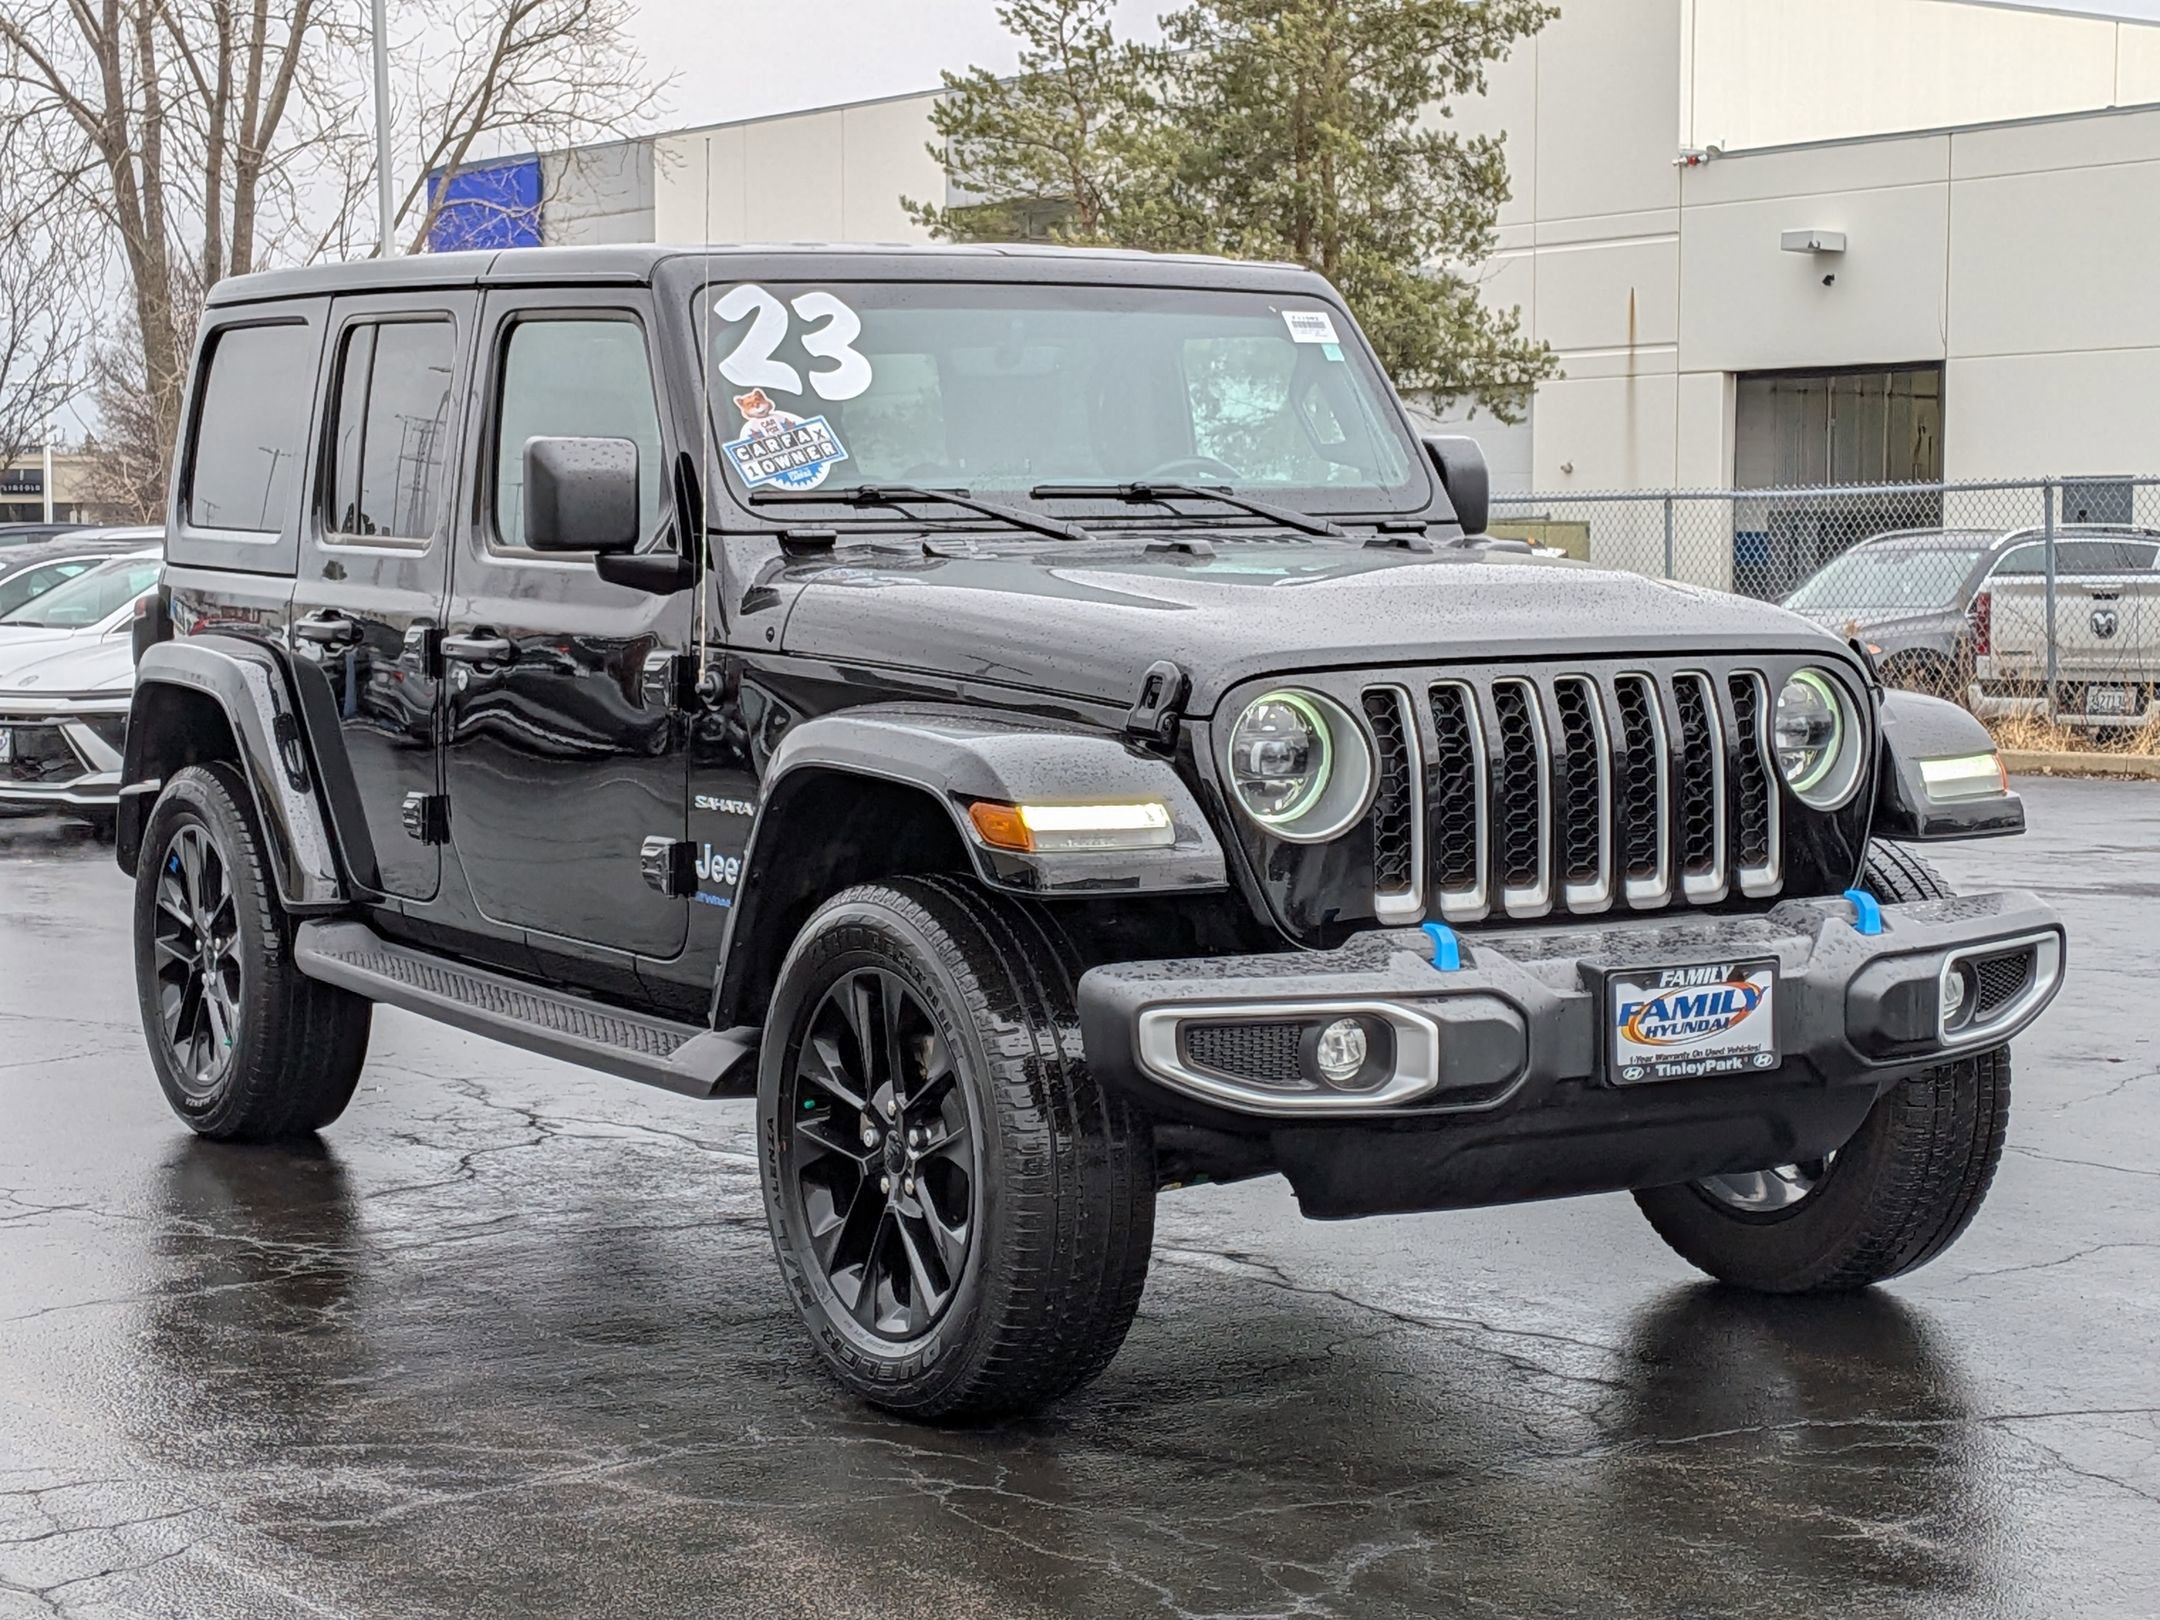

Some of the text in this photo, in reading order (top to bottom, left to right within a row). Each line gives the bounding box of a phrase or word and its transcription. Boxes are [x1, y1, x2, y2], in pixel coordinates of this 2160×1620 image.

[713, 284, 872, 400] 23
[736, 427, 827, 462] CARFAX
[746, 464, 760, 478] 1
[762, 442, 838, 474] OWNER
[694, 795, 754, 817] SAHARA
[695, 843, 740, 886] Jee
[1659, 965, 1735, 988] FAMILY
[1617, 985, 1770, 1027] FAMILY
[1645, 1016, 1732, 1039] HYUNDAI
[1655, 1051, 1691, 1062] Warranty
[1691, 1048, 1703, 1058] On
[1704, 1046, 1725, 1057] Used
[767, 1117, 784, 1211] ALENZA
